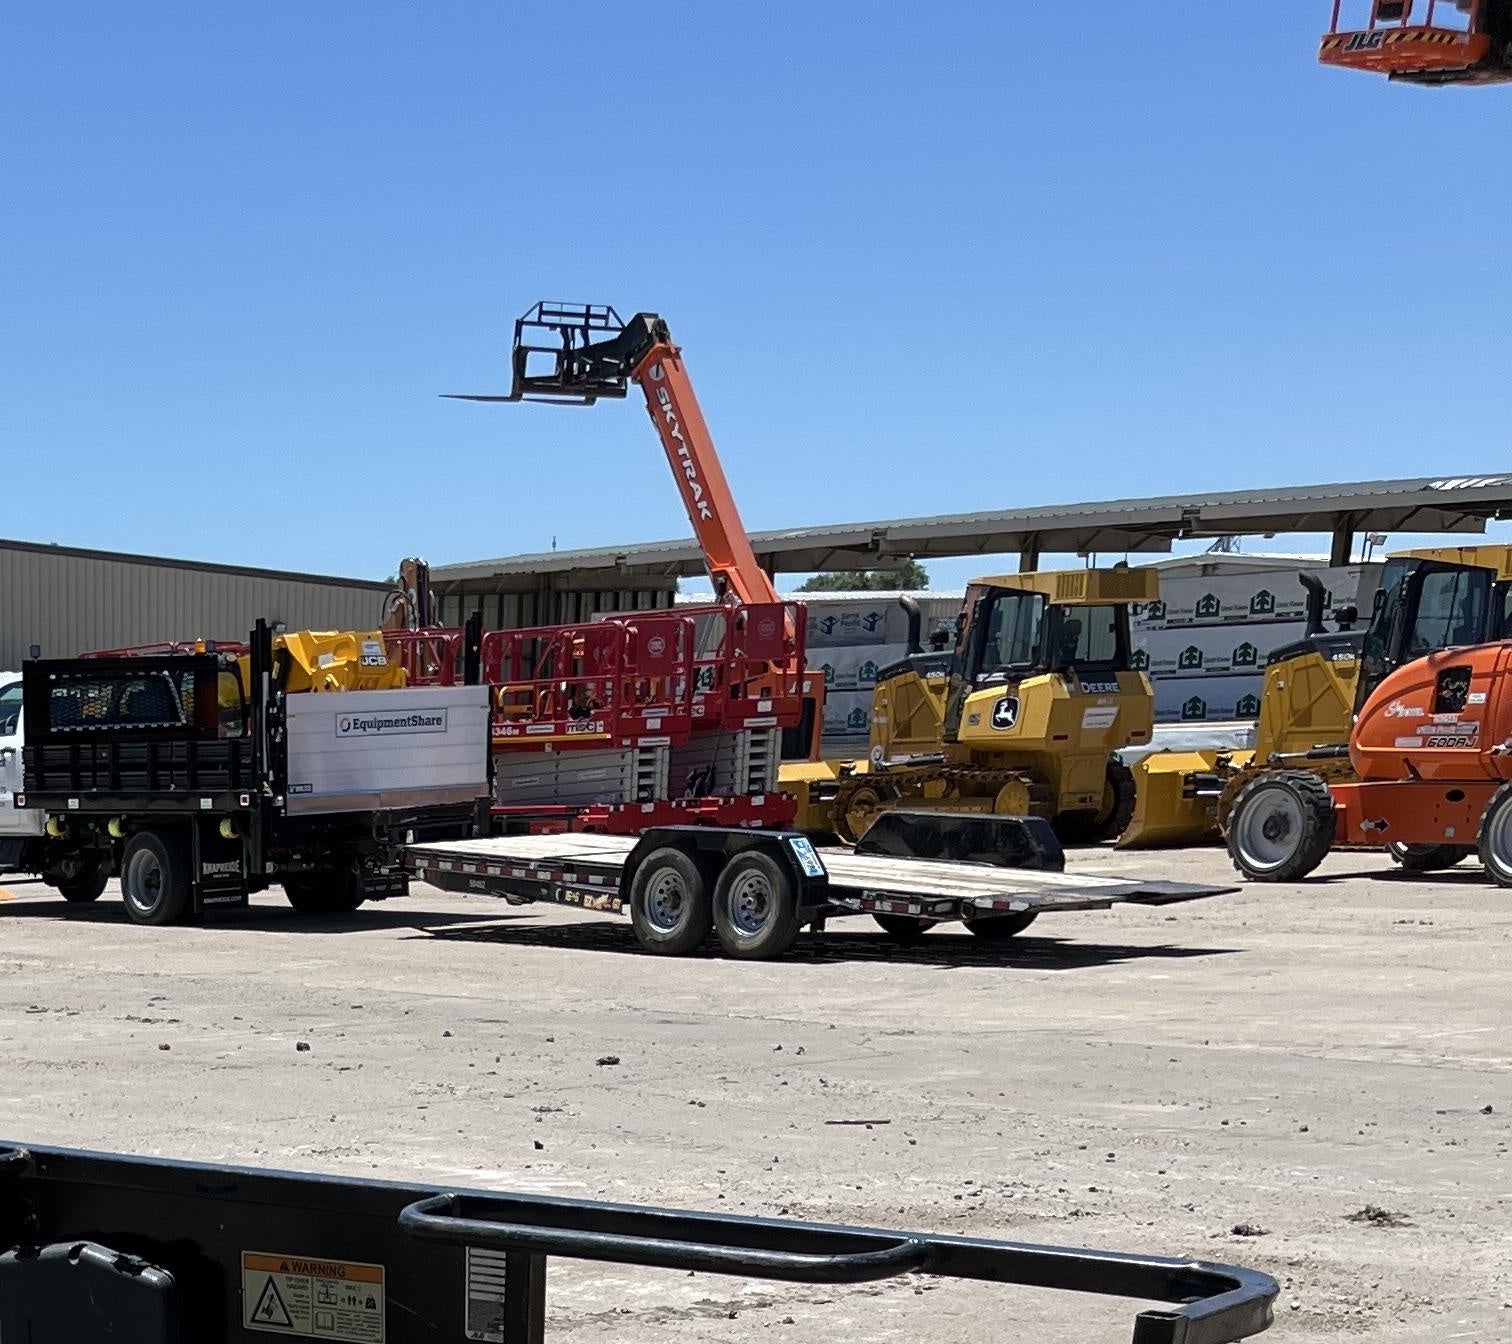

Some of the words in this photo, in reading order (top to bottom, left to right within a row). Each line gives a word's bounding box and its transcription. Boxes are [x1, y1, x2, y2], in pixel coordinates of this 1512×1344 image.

[1344, 31, 1384, 51] JLG
[656, 386, 713, 522] SKYTRAK
[361, 656, 387, 666] JCB
[1081, 682, 1120, 693] DEERE
[353, 714, 442, 731] EquipmentShare
[291, 1261, 346, 1277] WARNING
